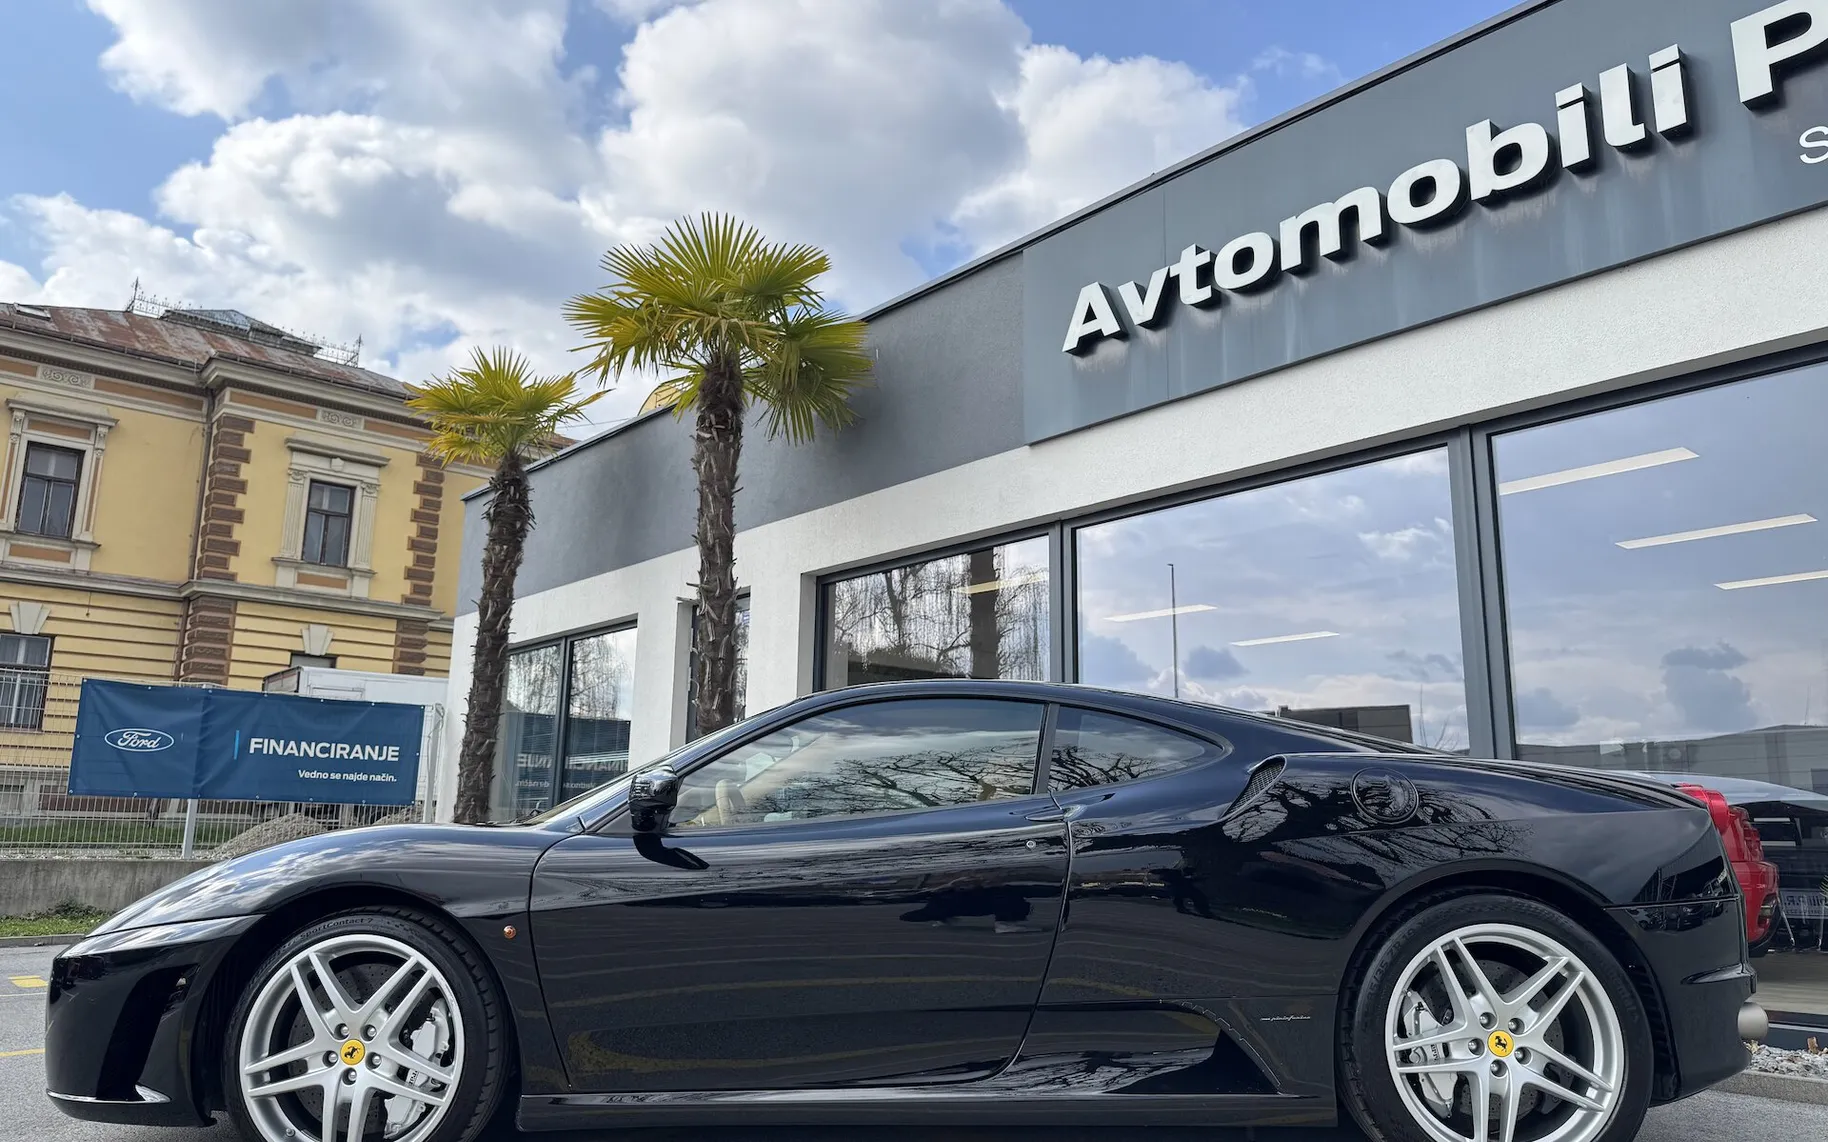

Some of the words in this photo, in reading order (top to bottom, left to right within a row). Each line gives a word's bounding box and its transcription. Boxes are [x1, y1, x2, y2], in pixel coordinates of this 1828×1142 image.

[1062, 44, 1690, 354] Avtomobili
[117, 730, 162, 748] Ford
[249, 737, 400, 761] FINANCIRANJE
[298, 769, 329, 780] Vedno
[330, 772, 342, 780] se
[343, 771, 369, 782] najde
[369, 772, 397, 782] način.
[300, 918, 364, 939] SportContact
